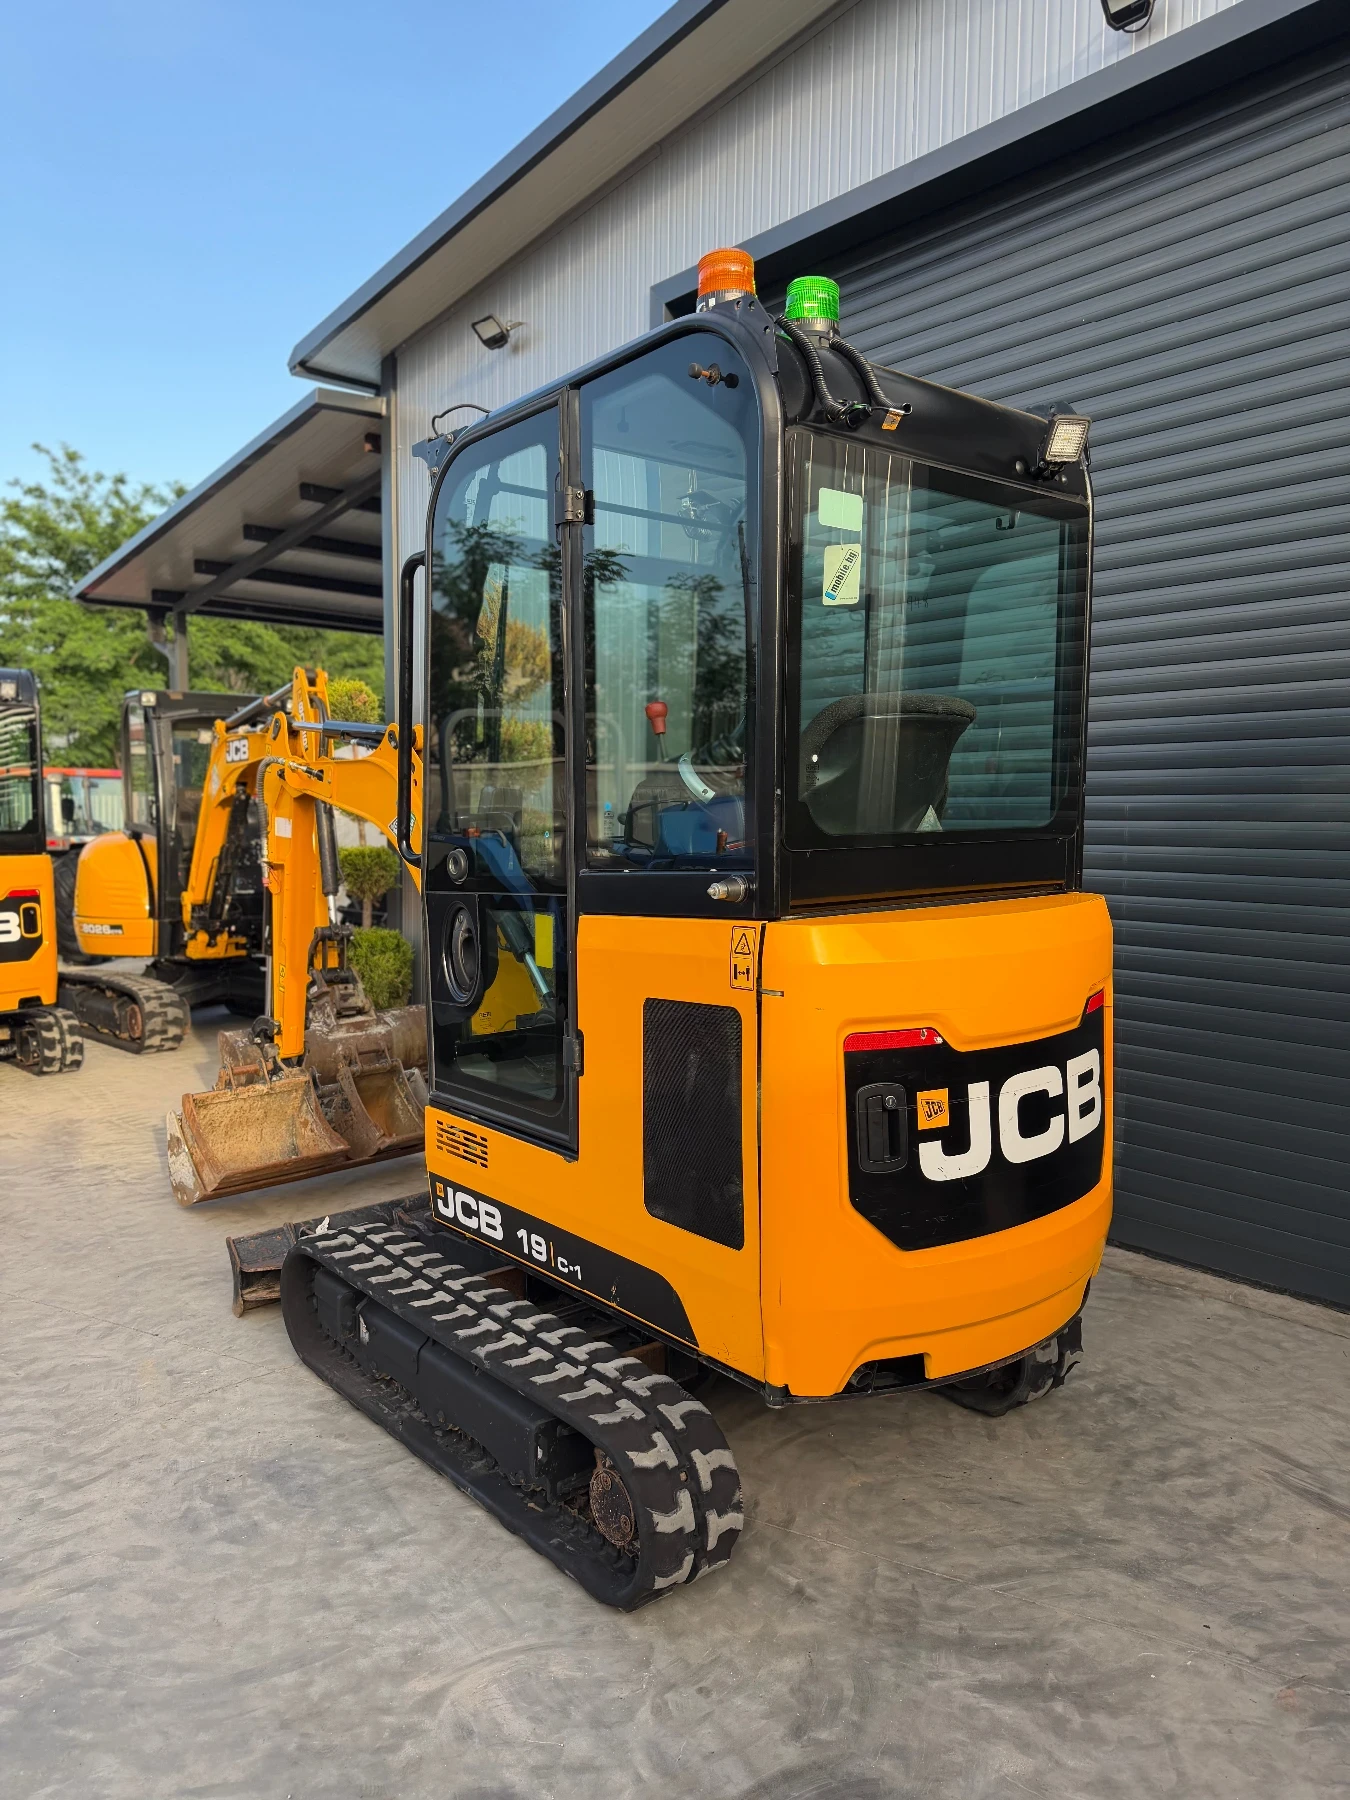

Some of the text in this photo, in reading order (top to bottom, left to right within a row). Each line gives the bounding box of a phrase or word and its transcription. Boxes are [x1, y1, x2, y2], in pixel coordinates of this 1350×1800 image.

[830, 550, 858, 595] mobile.bg
[226, 738, 249, 763] JCB
[918, 1047, 1102, 1182] JCB
[924, 1098, 944, 1119] JCB
[437, 1186, 504, 1241] JCB
[517, 1229, 547, 1262] 19
